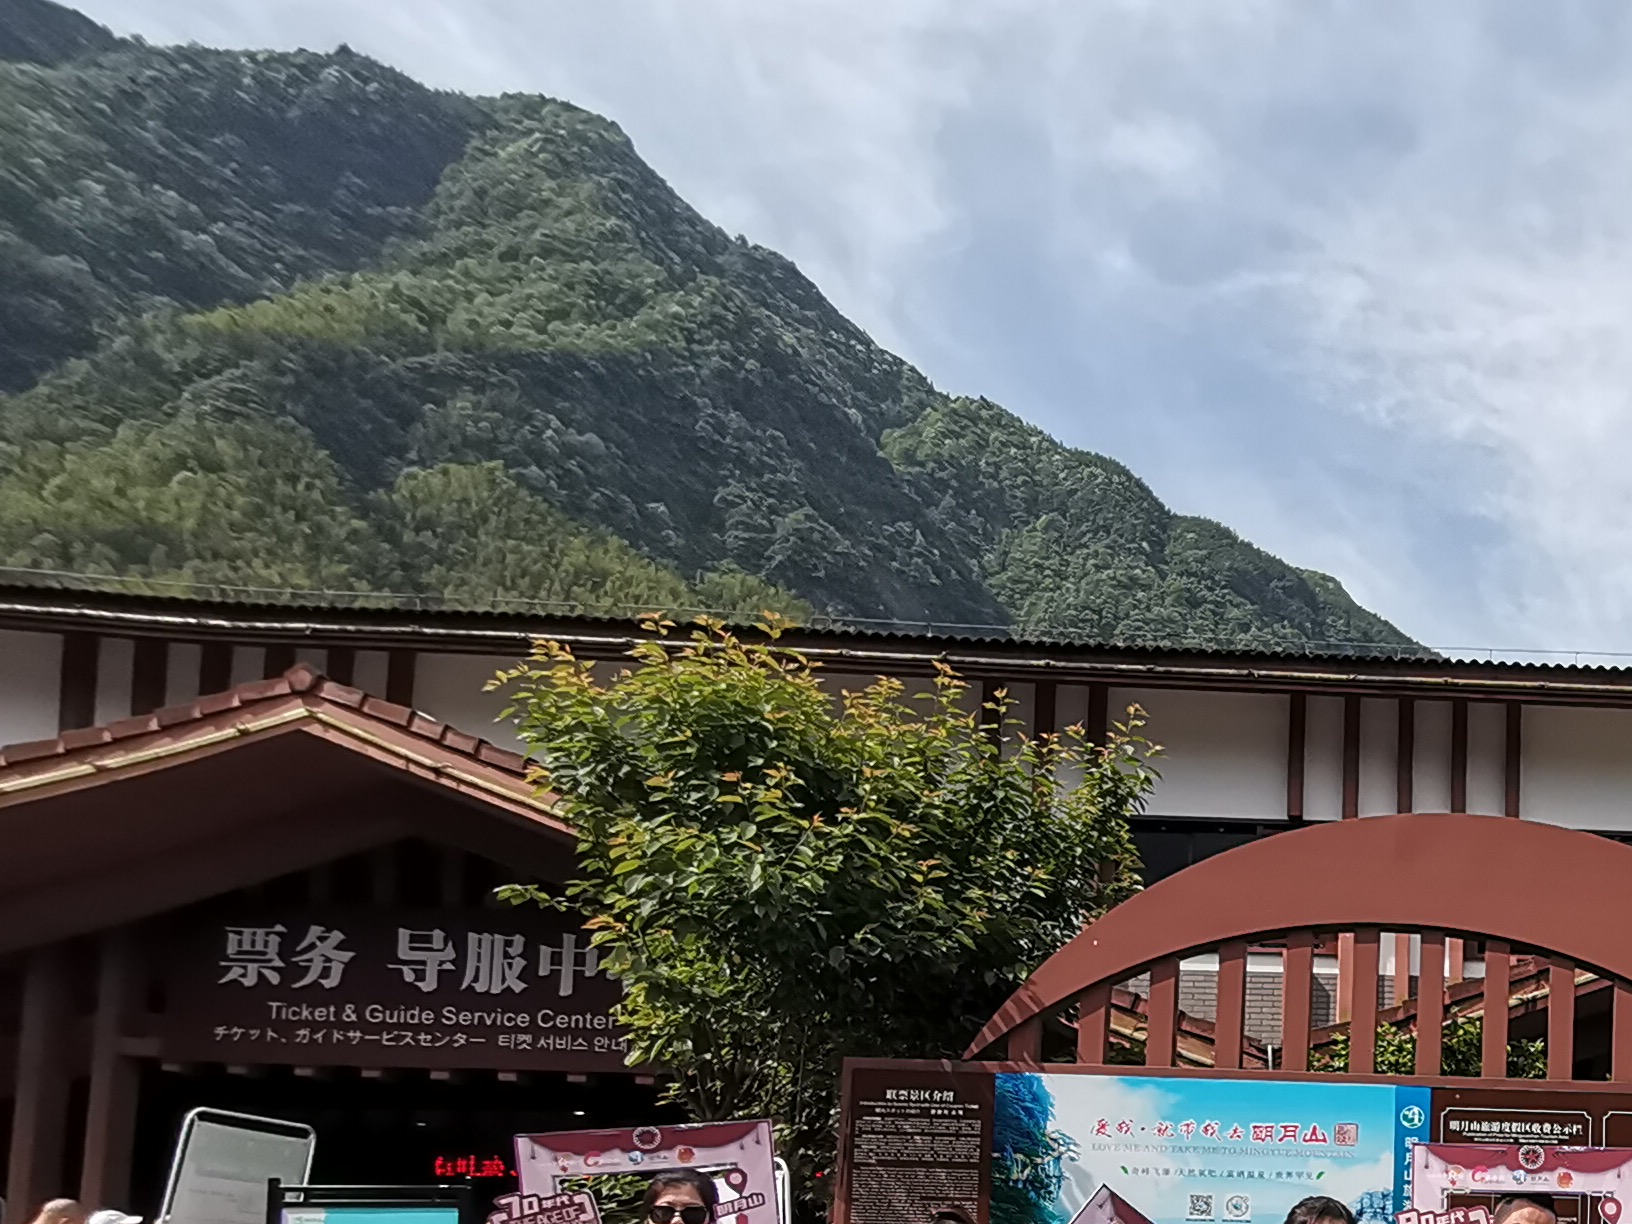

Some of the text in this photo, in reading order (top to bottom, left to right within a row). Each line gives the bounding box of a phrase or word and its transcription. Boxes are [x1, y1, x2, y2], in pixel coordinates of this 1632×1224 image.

[217, 923, 620, 997] 票务 导服中
[267, 1001, 618, 1030] Ticket & Guide Service Center
[498, 1033, 533, 1051] 티켓
[537, 1034, 588, 1051] 서비스
[1091, 1143, 1121, 1152] LOVE
[1122, 1144, 1141, 1153] ME
[1142, 1144, 1168, 1154] AND
[1169, 1144, 1200, 1155] TAKE
[1201, 1145, 1220, 1155] ME
[1221, 1146, 1237, 1156] TO
[716, 1194, 764, 1216] 明月山
